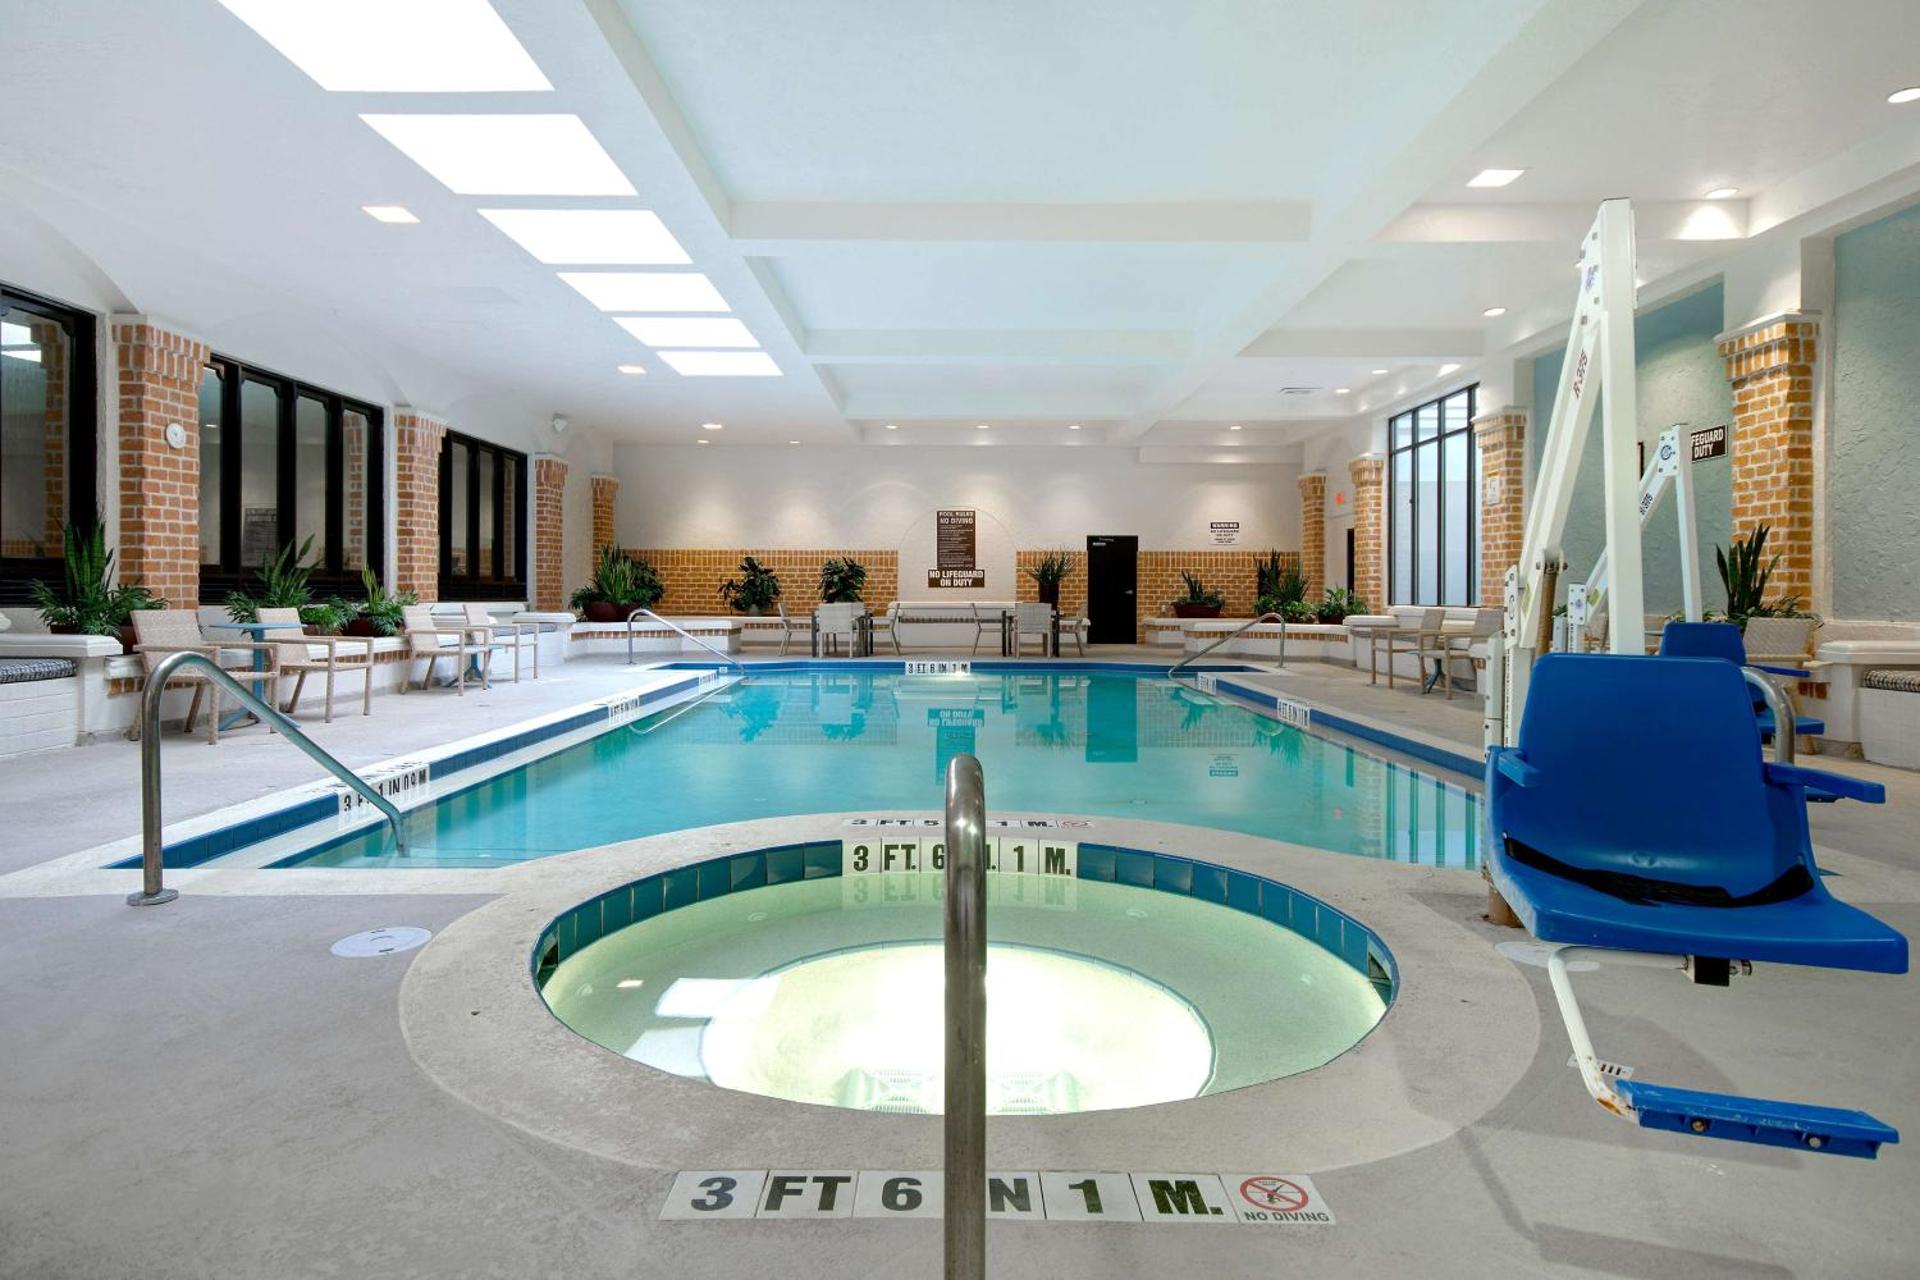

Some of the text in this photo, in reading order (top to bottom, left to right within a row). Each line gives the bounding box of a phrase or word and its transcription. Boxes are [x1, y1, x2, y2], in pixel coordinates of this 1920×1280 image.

[1691, 429, 1724, 448] FEGUARD
[1694, 443, 1714, 459] DUTY
[929, 570, 984, 578] NO LIFEGUARD
[940, 579, 973, 587] ON DUTY
[853, 845, 869, 872] 3
[884, 844, 917, 871] FT.
[932, 844, 946, 870] 6
[1013, 846, 1024, 872] 1
[1045, 847, 1071, 875] M.
[690, 1175, 1224, 1216] 3 FT 6 N 1 M.
[1244, 1211, 1330, 1222] NO DIVING
